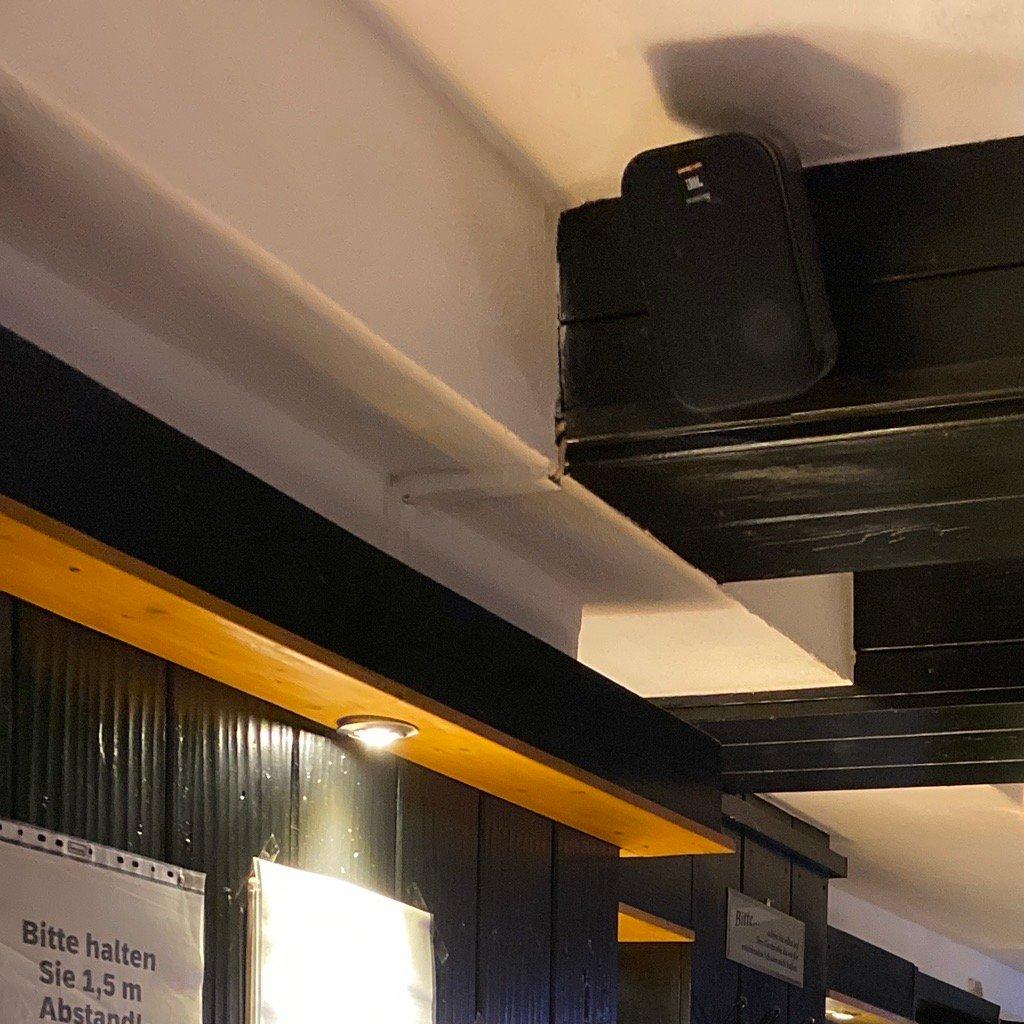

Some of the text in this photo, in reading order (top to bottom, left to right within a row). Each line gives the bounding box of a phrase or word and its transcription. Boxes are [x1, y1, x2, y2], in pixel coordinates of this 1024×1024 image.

[22, 920, 156, 971] Bitte halten
[39, 960, 142, 1002] Sie 1,5 m
